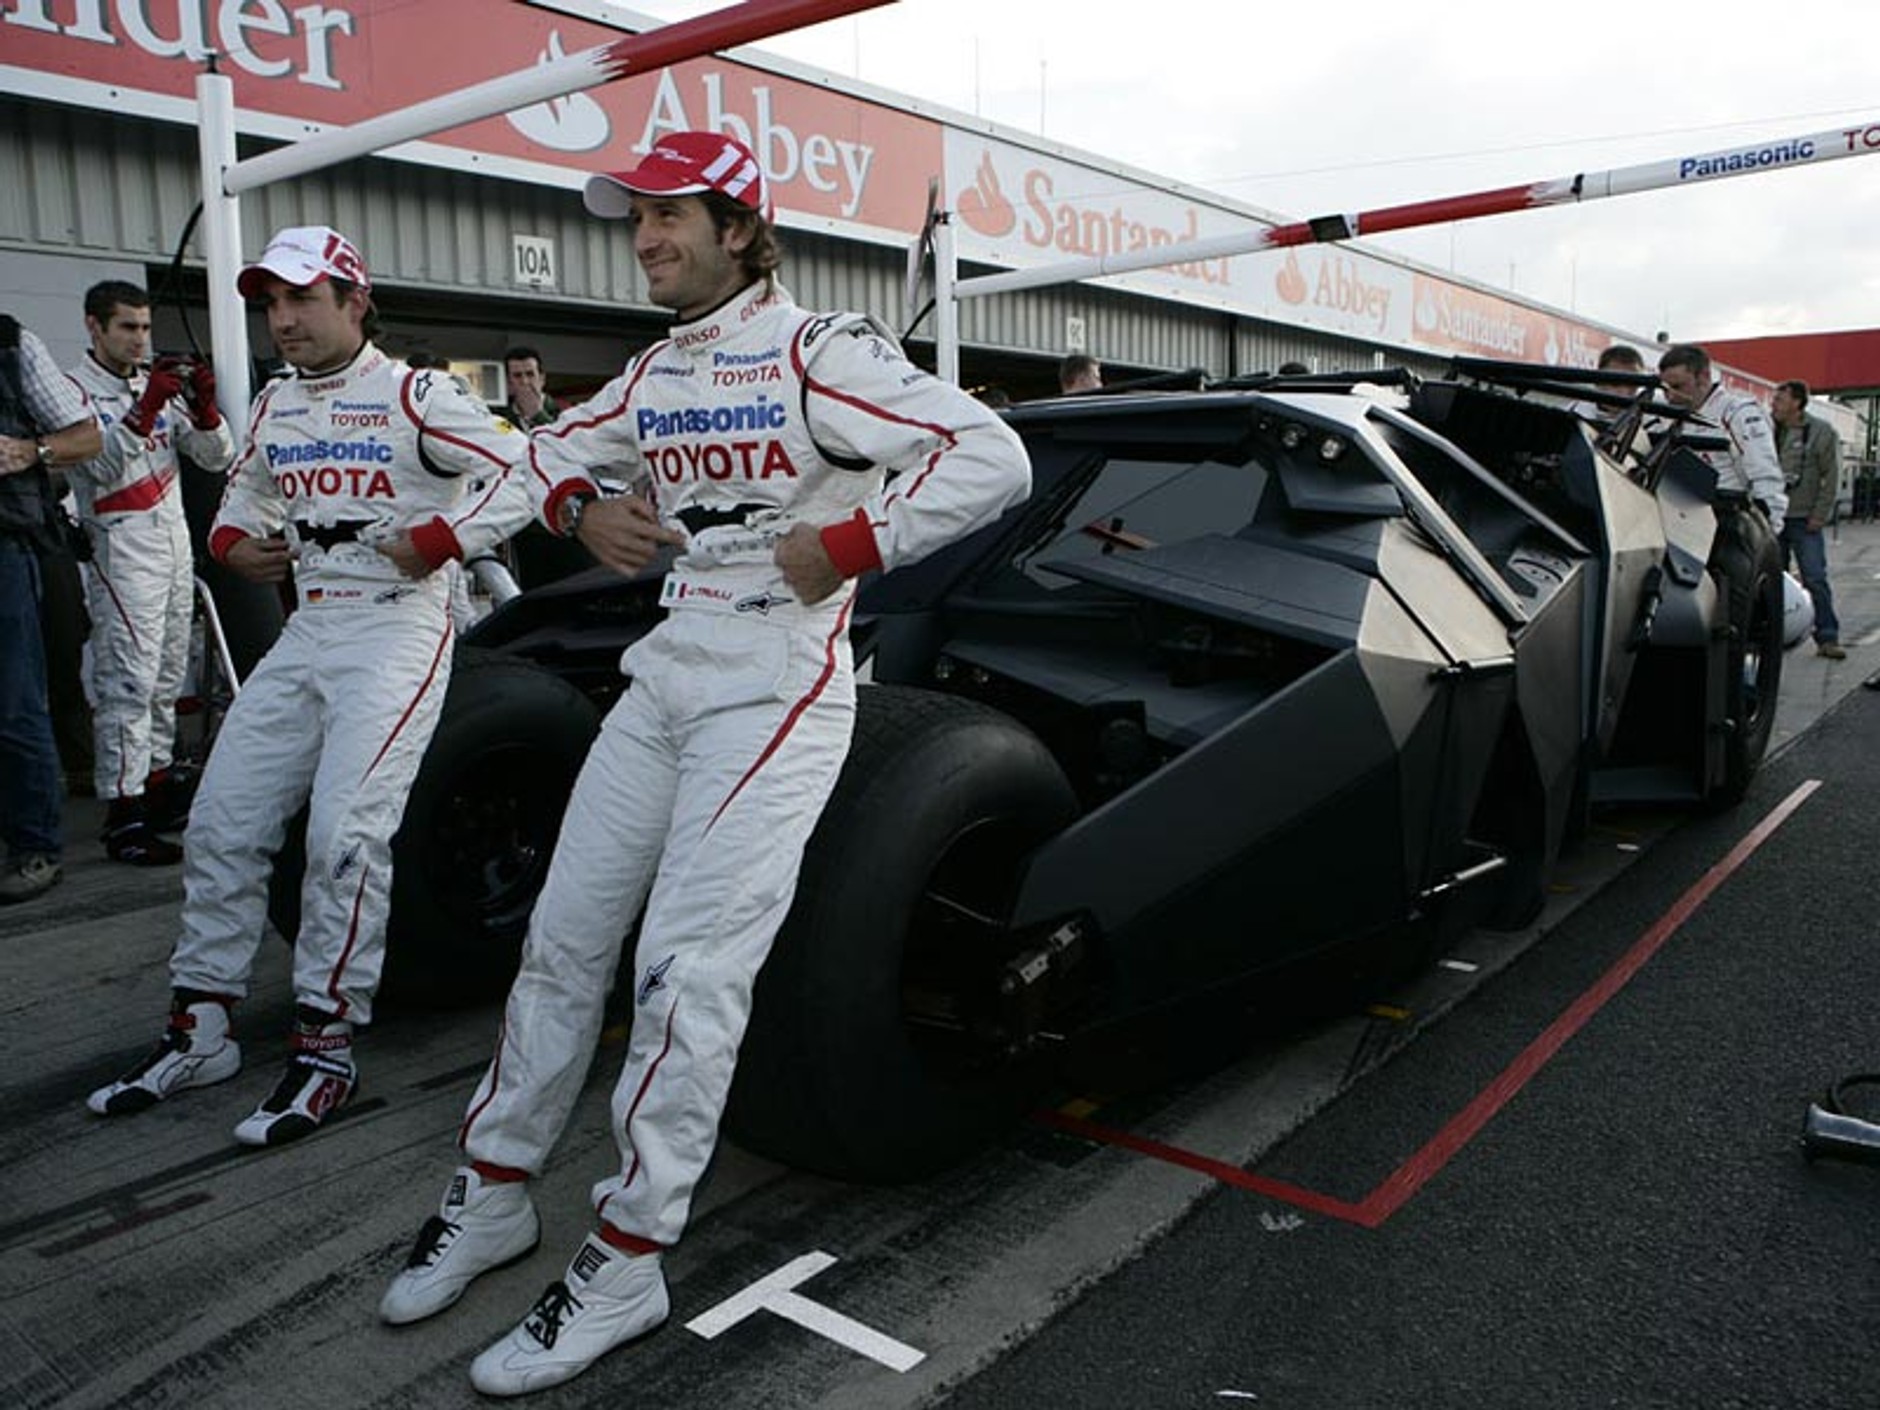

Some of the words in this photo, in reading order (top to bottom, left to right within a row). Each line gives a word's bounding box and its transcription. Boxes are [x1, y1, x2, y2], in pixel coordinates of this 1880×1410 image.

[632, 66, 873, 216] Abbey
[1680, 140, 1814, 179] Panasonic
[517, 244, 551, 277] 10A
[1313, 258, 1391, 331] Abbey
[674, 324, 721, 349] DENSO
[1440, 292, 1526, 356] Santander
[713, 346, 782, 367] Panasonic
[711, 364, 782, 387] TOYOTA
[329, 413, 390, 428] TOYOTA
[636, 395, 787, 440] Panasonic
[266, 437, 393, 468] Panasonic
[643, 440, 798, 485] TOYOTA
